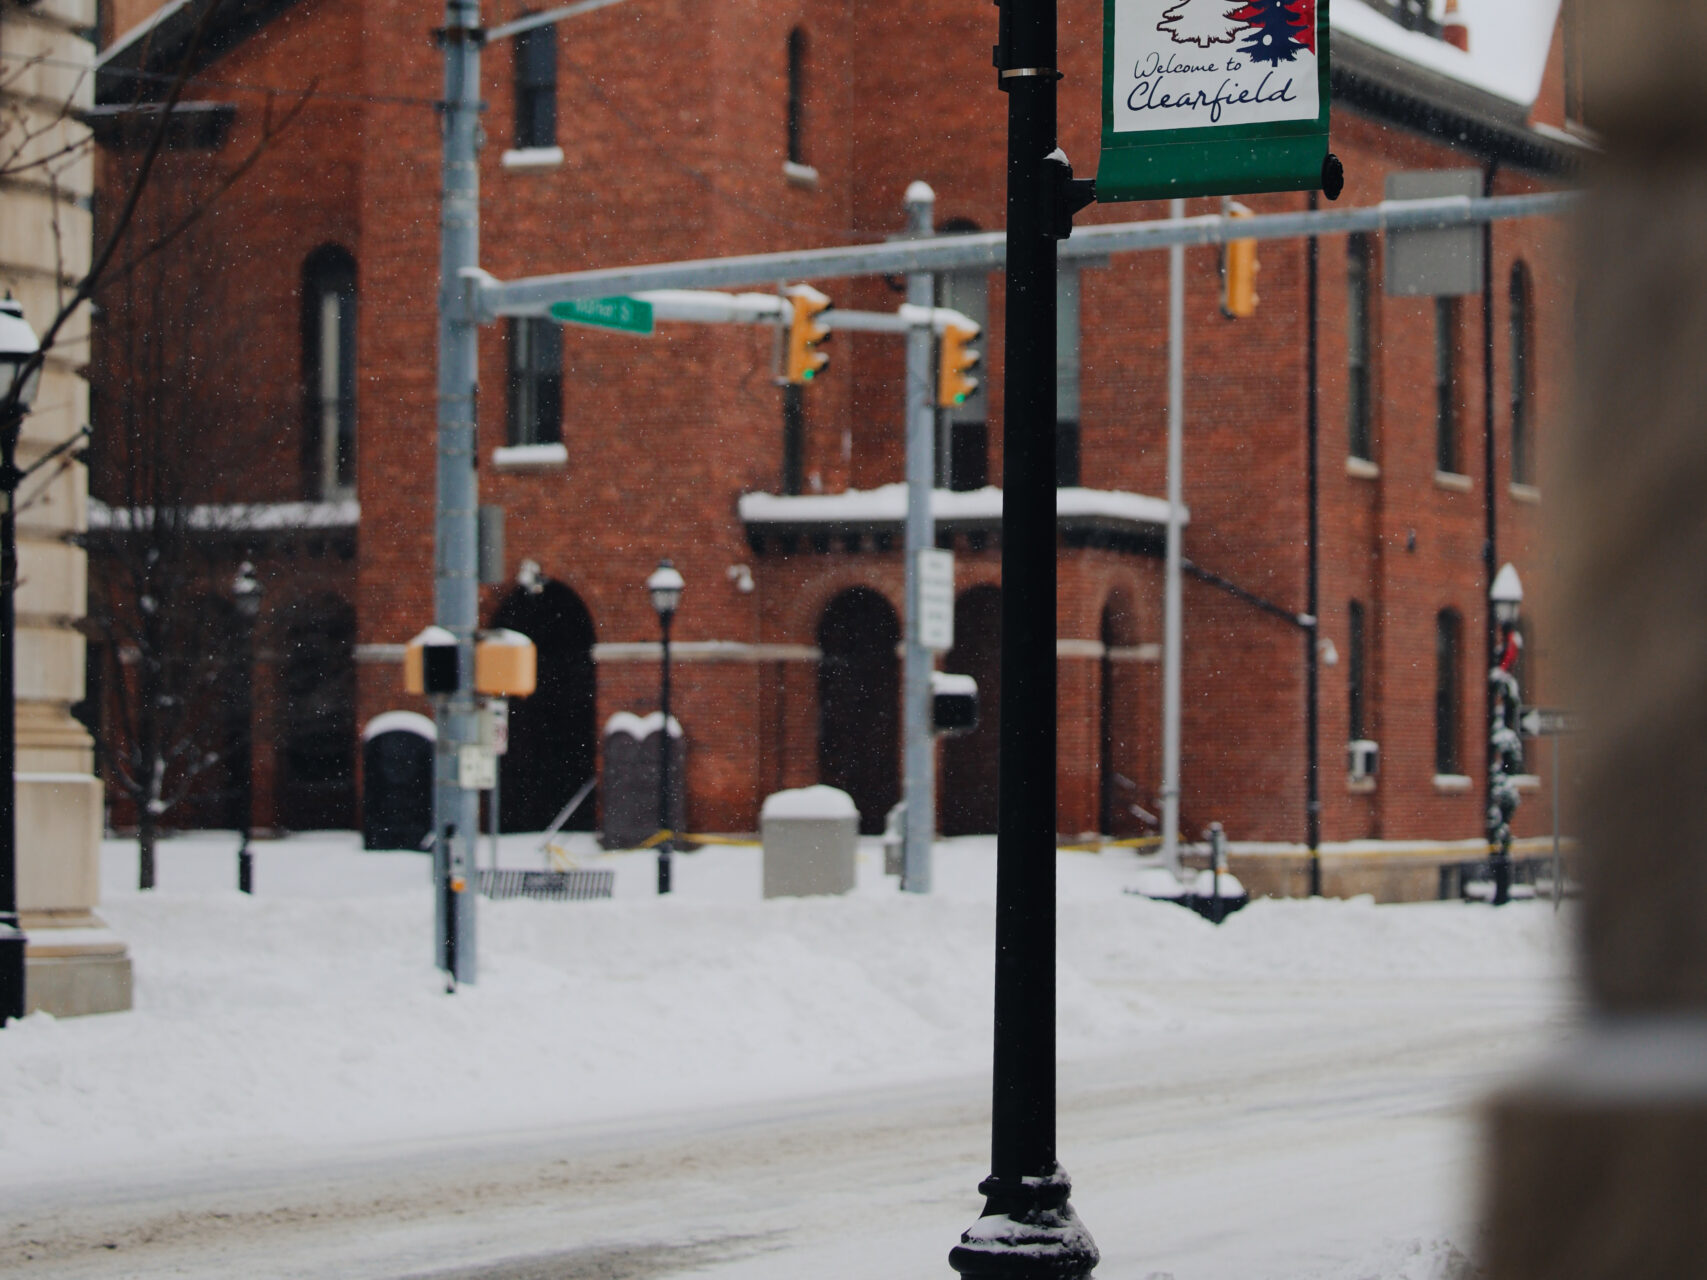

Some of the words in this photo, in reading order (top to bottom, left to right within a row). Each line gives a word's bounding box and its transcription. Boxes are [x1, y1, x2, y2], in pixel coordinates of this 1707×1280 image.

[1134, 51, 1219, 79] Welcome
[1226, 57, 1242, 71] to
[1127, 71, 1297, 123] Clearfield
